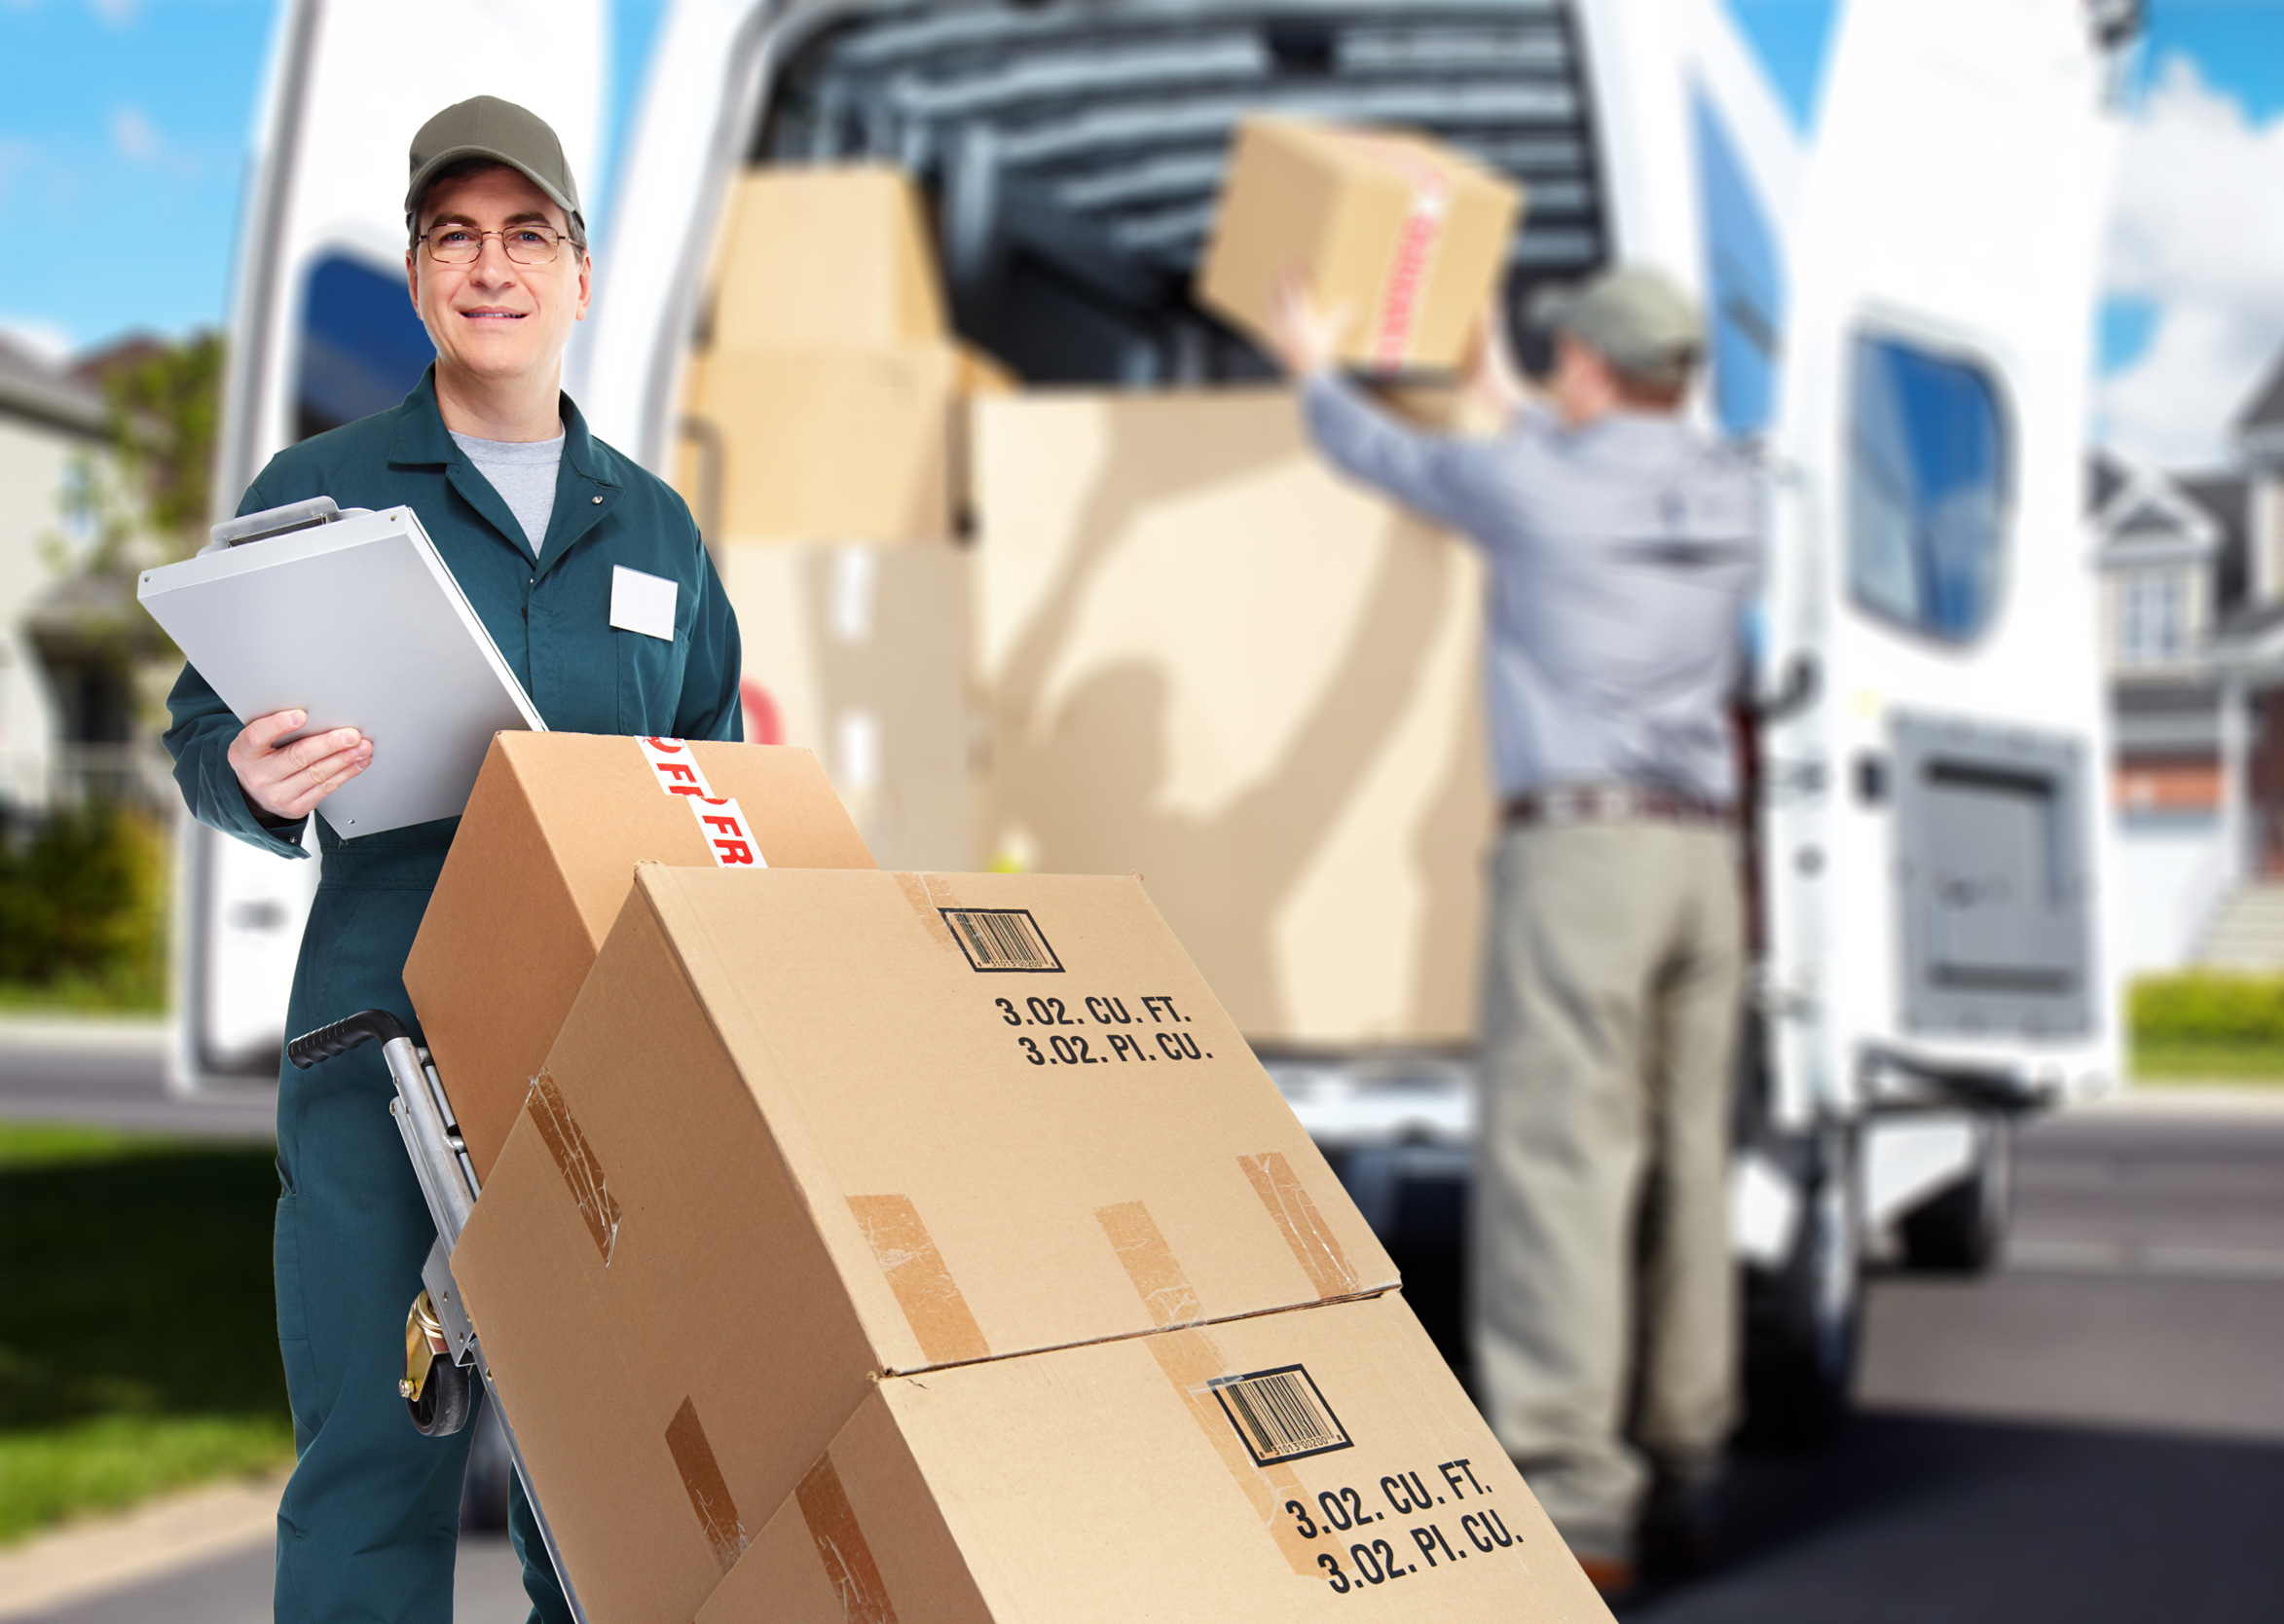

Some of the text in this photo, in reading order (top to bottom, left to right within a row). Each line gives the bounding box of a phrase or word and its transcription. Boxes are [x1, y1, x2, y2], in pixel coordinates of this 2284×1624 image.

[995, 996, 1192, 1026] 3.02. CU. FT.
[1017, 1032, 1214, 1066] 3.02. PI. CU.
[1272, 1442, 1301, 1456] 31013
[1302, 1436, 1329, 1450] 00200
[1285, 1458, 1492, 1539] 3.02. CU. FT.
[1317, 1509, 1524, 1594] 3.02. PI. CU.
